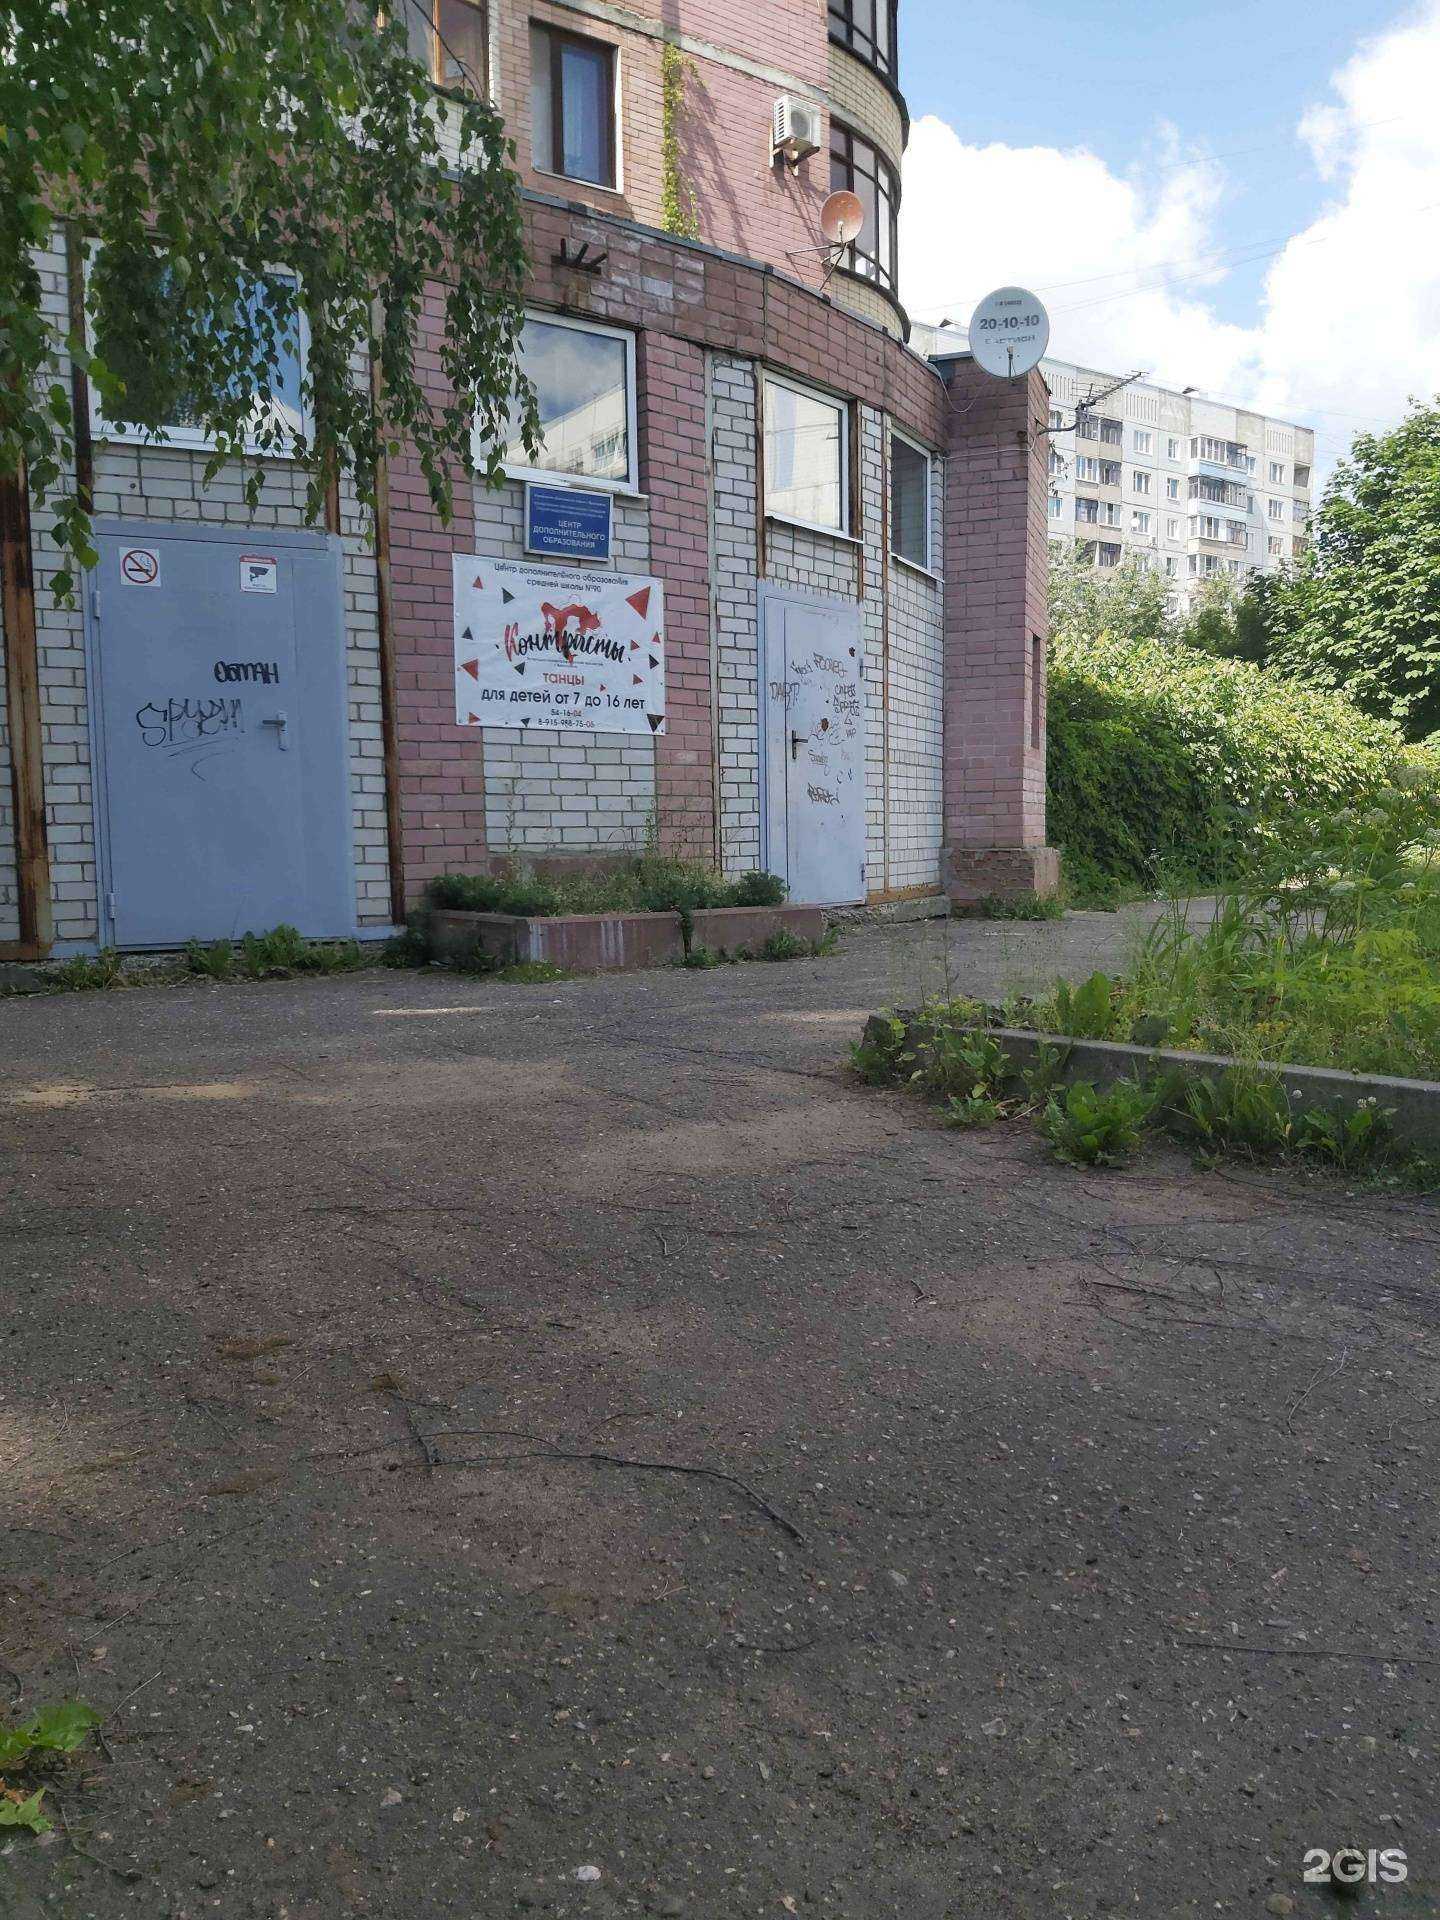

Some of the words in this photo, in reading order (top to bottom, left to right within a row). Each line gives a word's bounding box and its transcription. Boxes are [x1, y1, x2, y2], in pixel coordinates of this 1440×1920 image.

[980, 315, 1040, 330] 20-10-10
[558, 520, 582, 529] ЦЕНТР
[532, 525, 606, 541] ДОПОЛНИТЕЛЬНОГО
[542, 536, 596, 549] ОБРАЗОВАНИЯ
[494, 563, 518, 574] Центр
[526, 579, 559, 588] средней
[561, 582, 584, 591] школы
[542, 672, 585, 687] танцы
[481, 688, 506, 702] для
[509, 690, 551, 704] детей
[555, 693, 570, 705] от
[573, 692, 581, 705] 7
[585, 696, 601, 708] до
[606, 694, 621, 708] 16
[623, 698, 646, 710] лет
